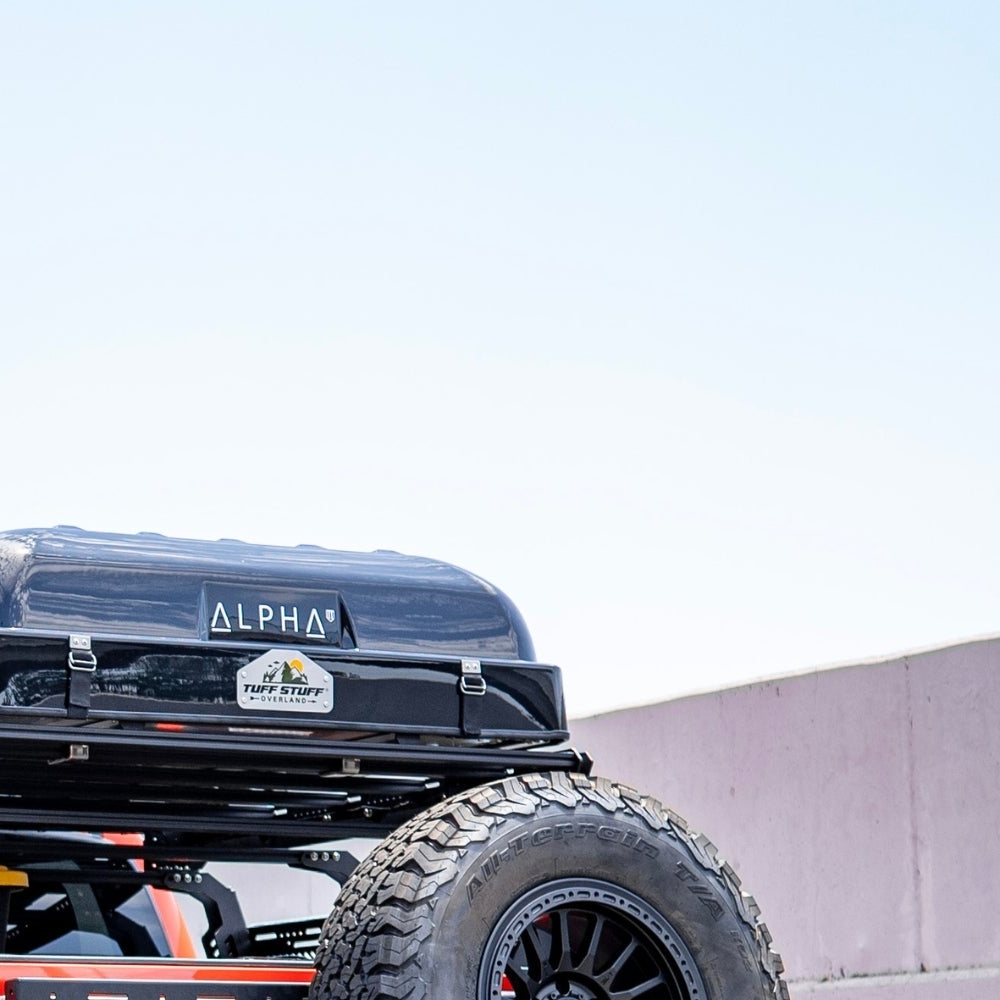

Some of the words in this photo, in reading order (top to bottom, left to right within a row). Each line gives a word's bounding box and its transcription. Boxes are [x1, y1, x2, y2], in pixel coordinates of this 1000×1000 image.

[211, 602, 326, 639] ALPHA
[243, 684, 278, 694] TUFF
[280, 685, 324, 697] STUFF
[260, 695, 307, 704] OVERLAND
